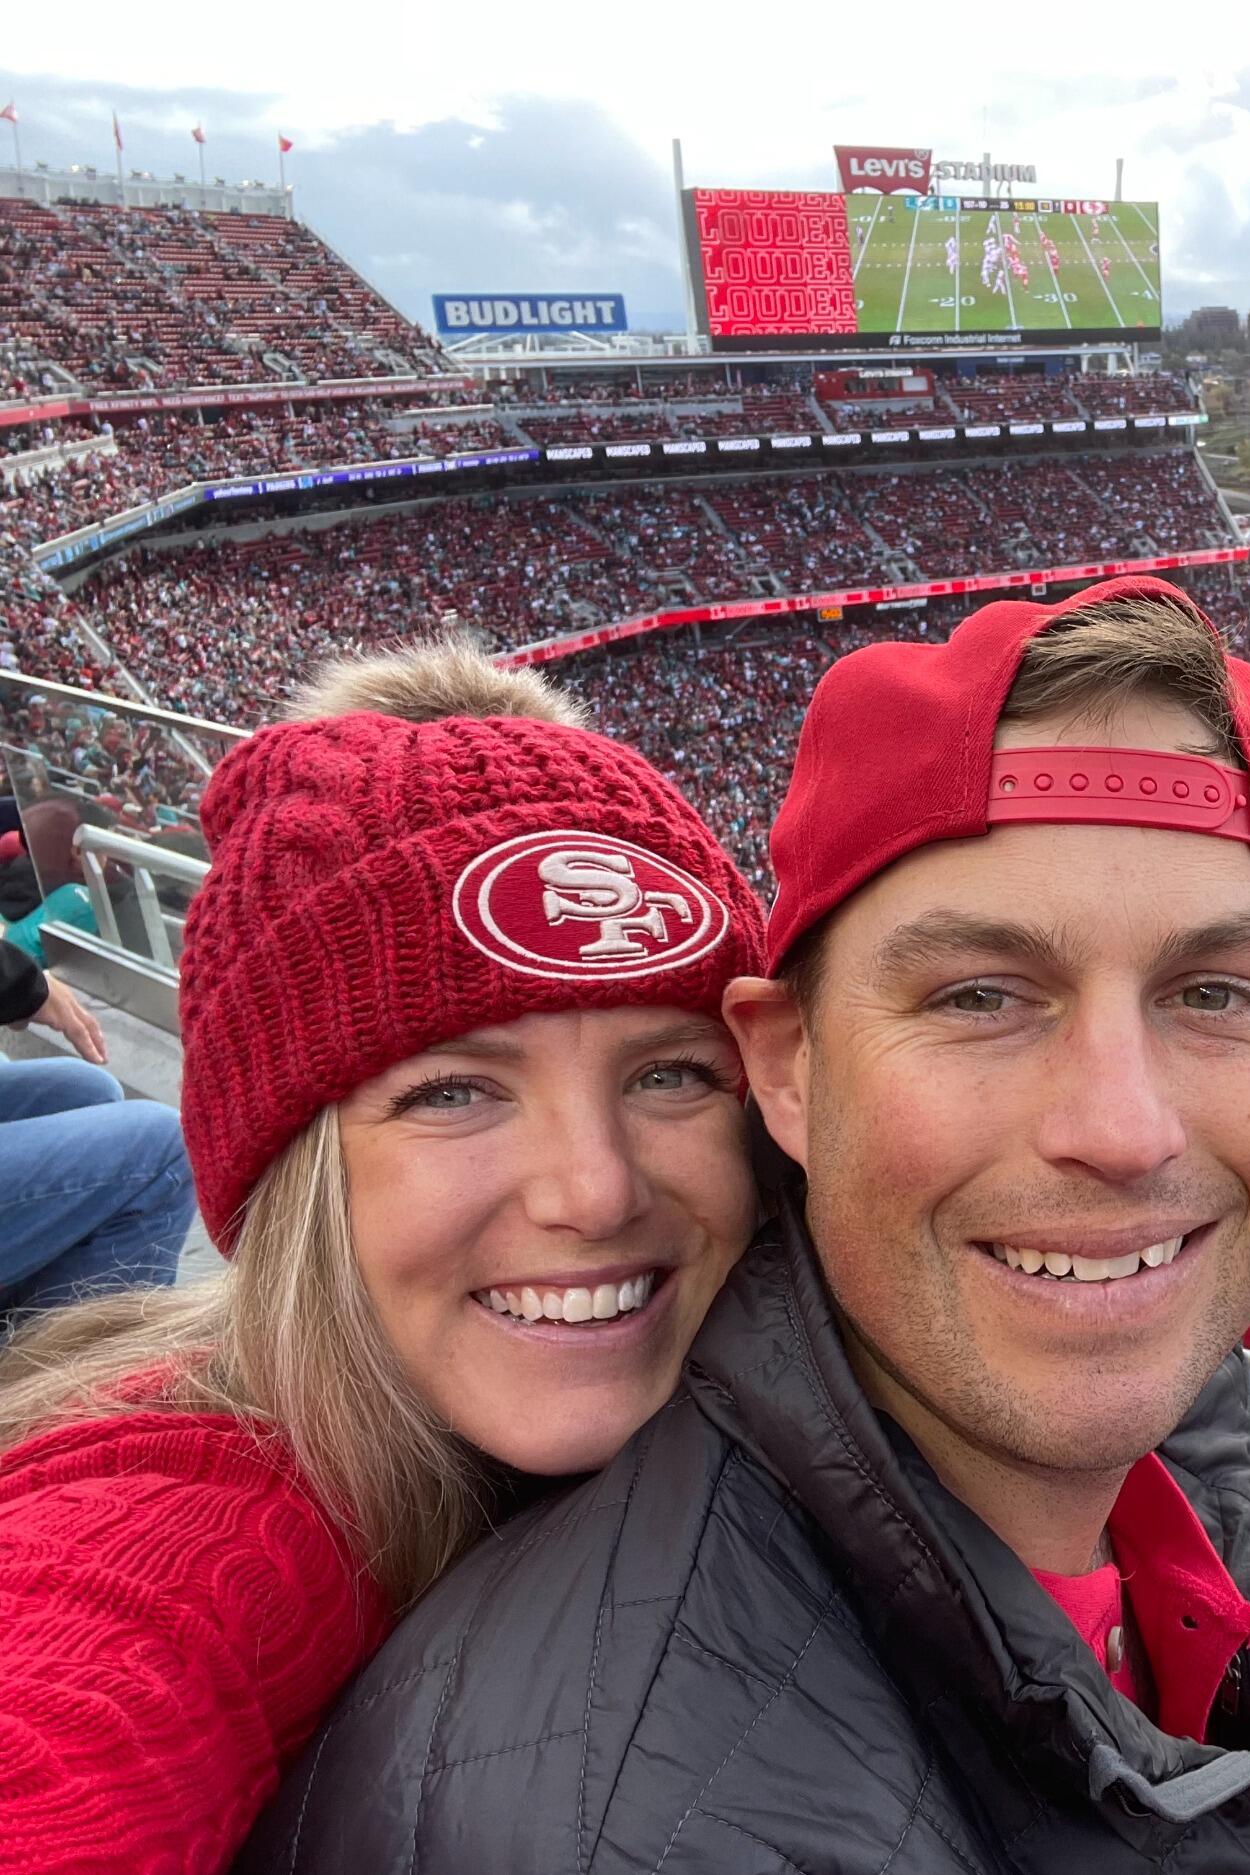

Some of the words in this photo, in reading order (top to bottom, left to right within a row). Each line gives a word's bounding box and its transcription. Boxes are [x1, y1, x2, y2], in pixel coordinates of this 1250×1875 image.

[937, 160, 1037, 184] STADIUM
[697, 208, 848, 247] LOUDER
[702, 247, 854, 284] LOUDER
[705, 285, 858, 322] LOUDER
[903, 335, 943, 346] Foxconn
[945, 334, 986, 345] Industrial
[987, 334, 1022, 344] Internet
